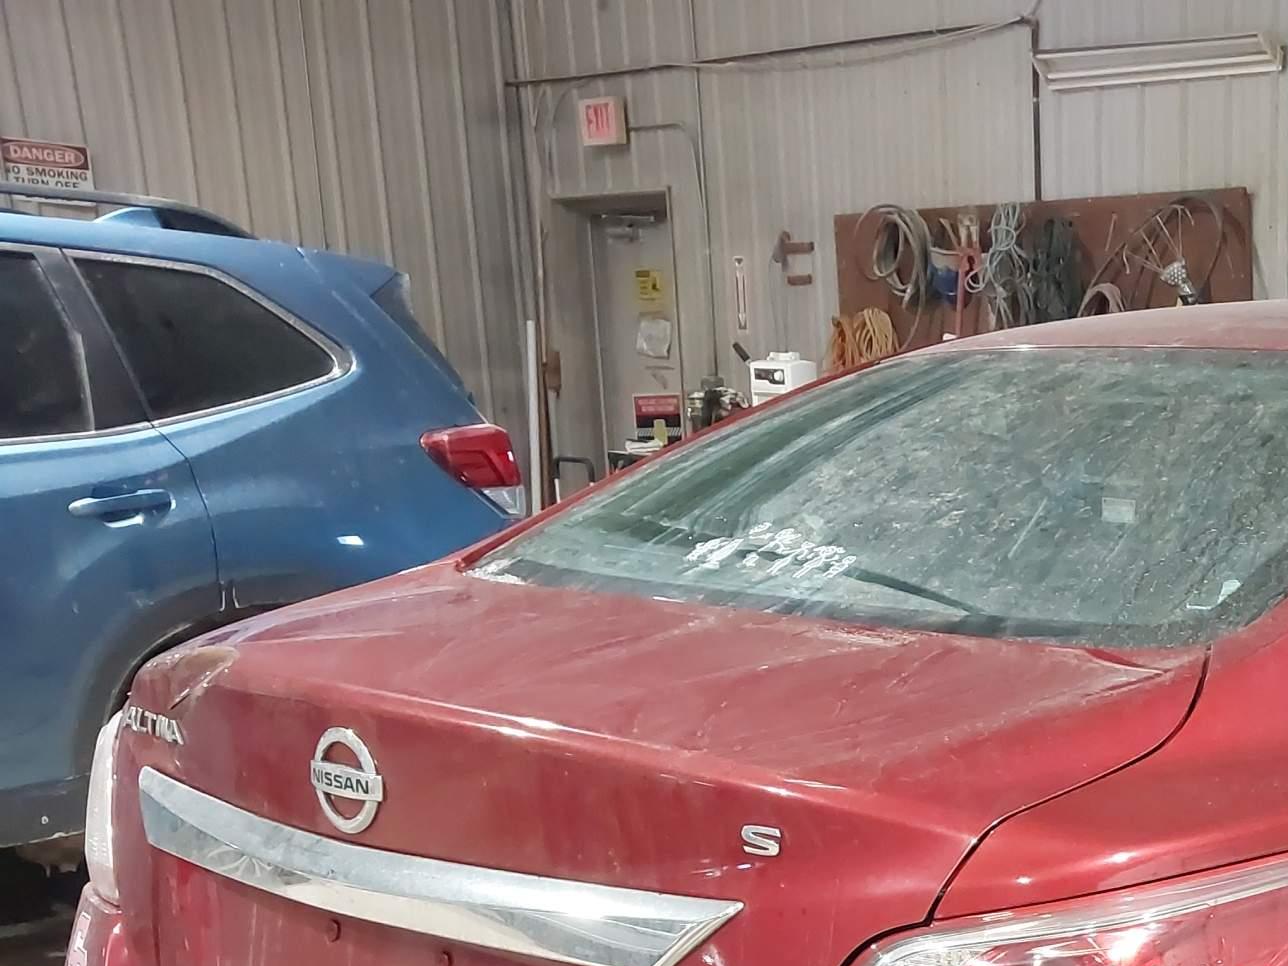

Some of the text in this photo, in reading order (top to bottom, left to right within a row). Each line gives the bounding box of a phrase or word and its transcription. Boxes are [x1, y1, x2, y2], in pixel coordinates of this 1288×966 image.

[585, 102, 611, 139] EXIT
[9, 144, 76, 163] DANGER
[26, 167, 88, 181] SMOKING
[123, 706, 184, 745] ALTIMA
[311, 767, 370, 795] NISSAN
[741, 825, 781, 856] S
